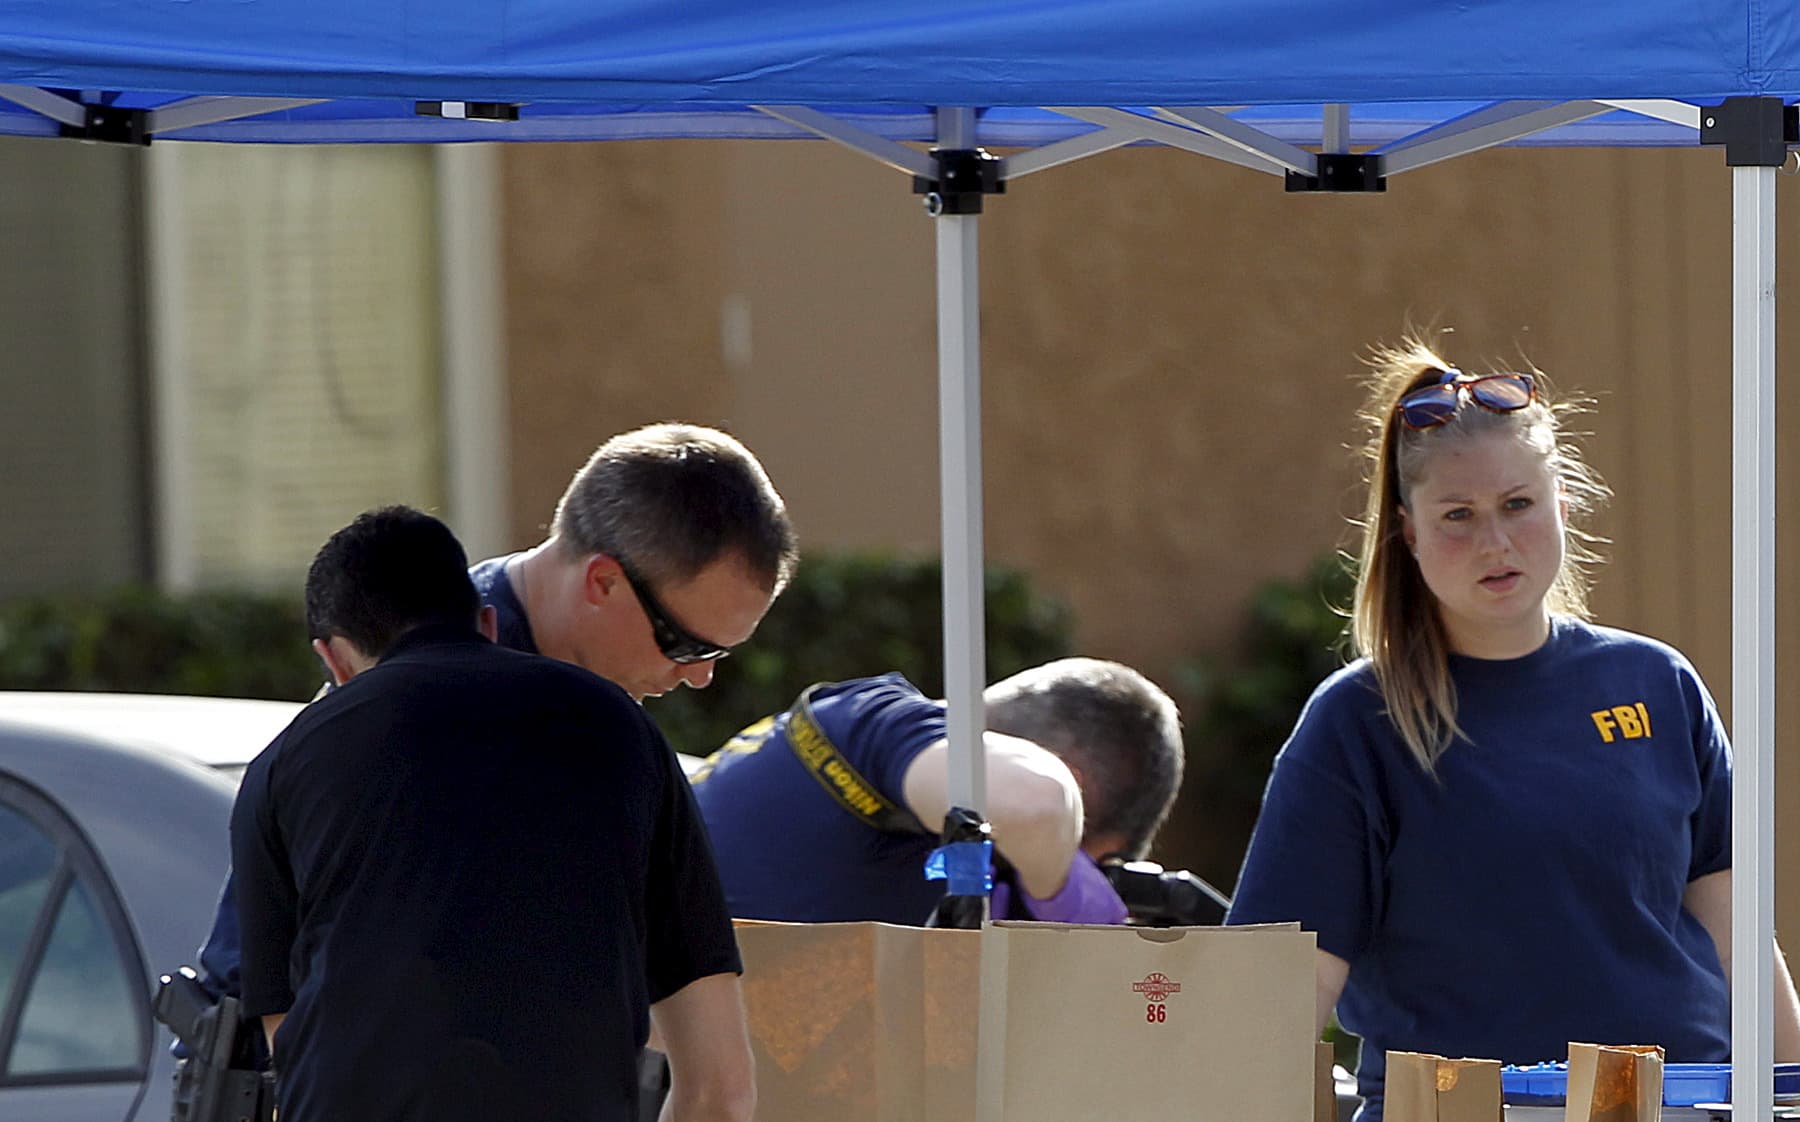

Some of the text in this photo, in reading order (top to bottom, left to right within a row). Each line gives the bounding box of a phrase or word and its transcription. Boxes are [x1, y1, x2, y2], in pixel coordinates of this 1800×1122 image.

[1591, 702, 1652, 742] FBI
[823, 759, 881, 815] Nikon
[1147, 1004, 1166, 1023] 86
